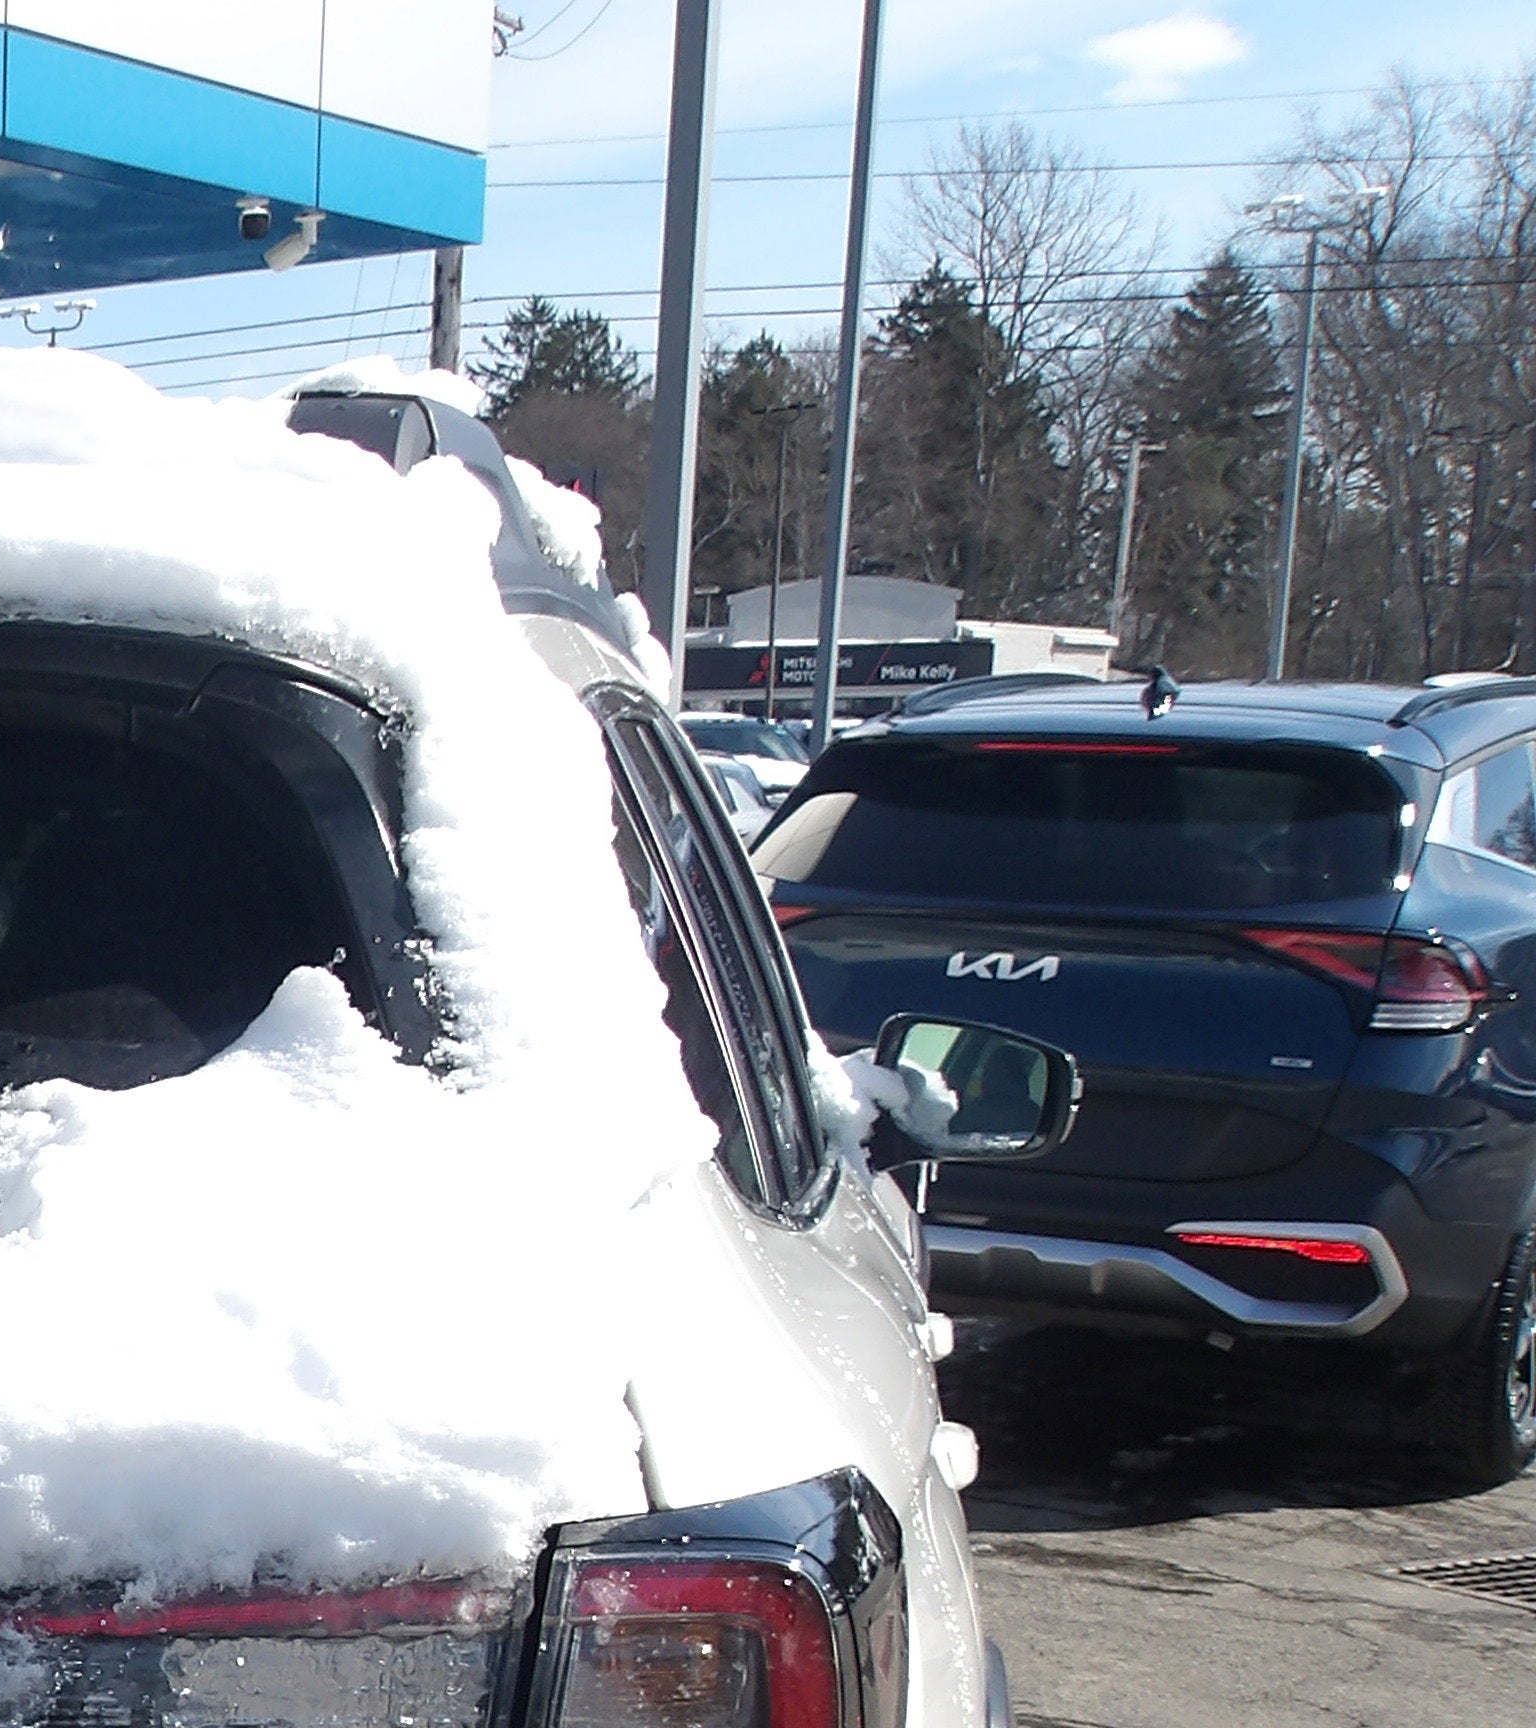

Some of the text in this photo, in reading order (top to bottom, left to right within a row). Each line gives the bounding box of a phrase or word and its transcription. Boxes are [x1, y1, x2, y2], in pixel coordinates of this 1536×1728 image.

[782, 656, 854, 670] MITSHI
[781, 670, 817, 683] MOTO
[880, 663, 958, 682] Mike Kelly
[946, 951, 1061, 982] KIA
